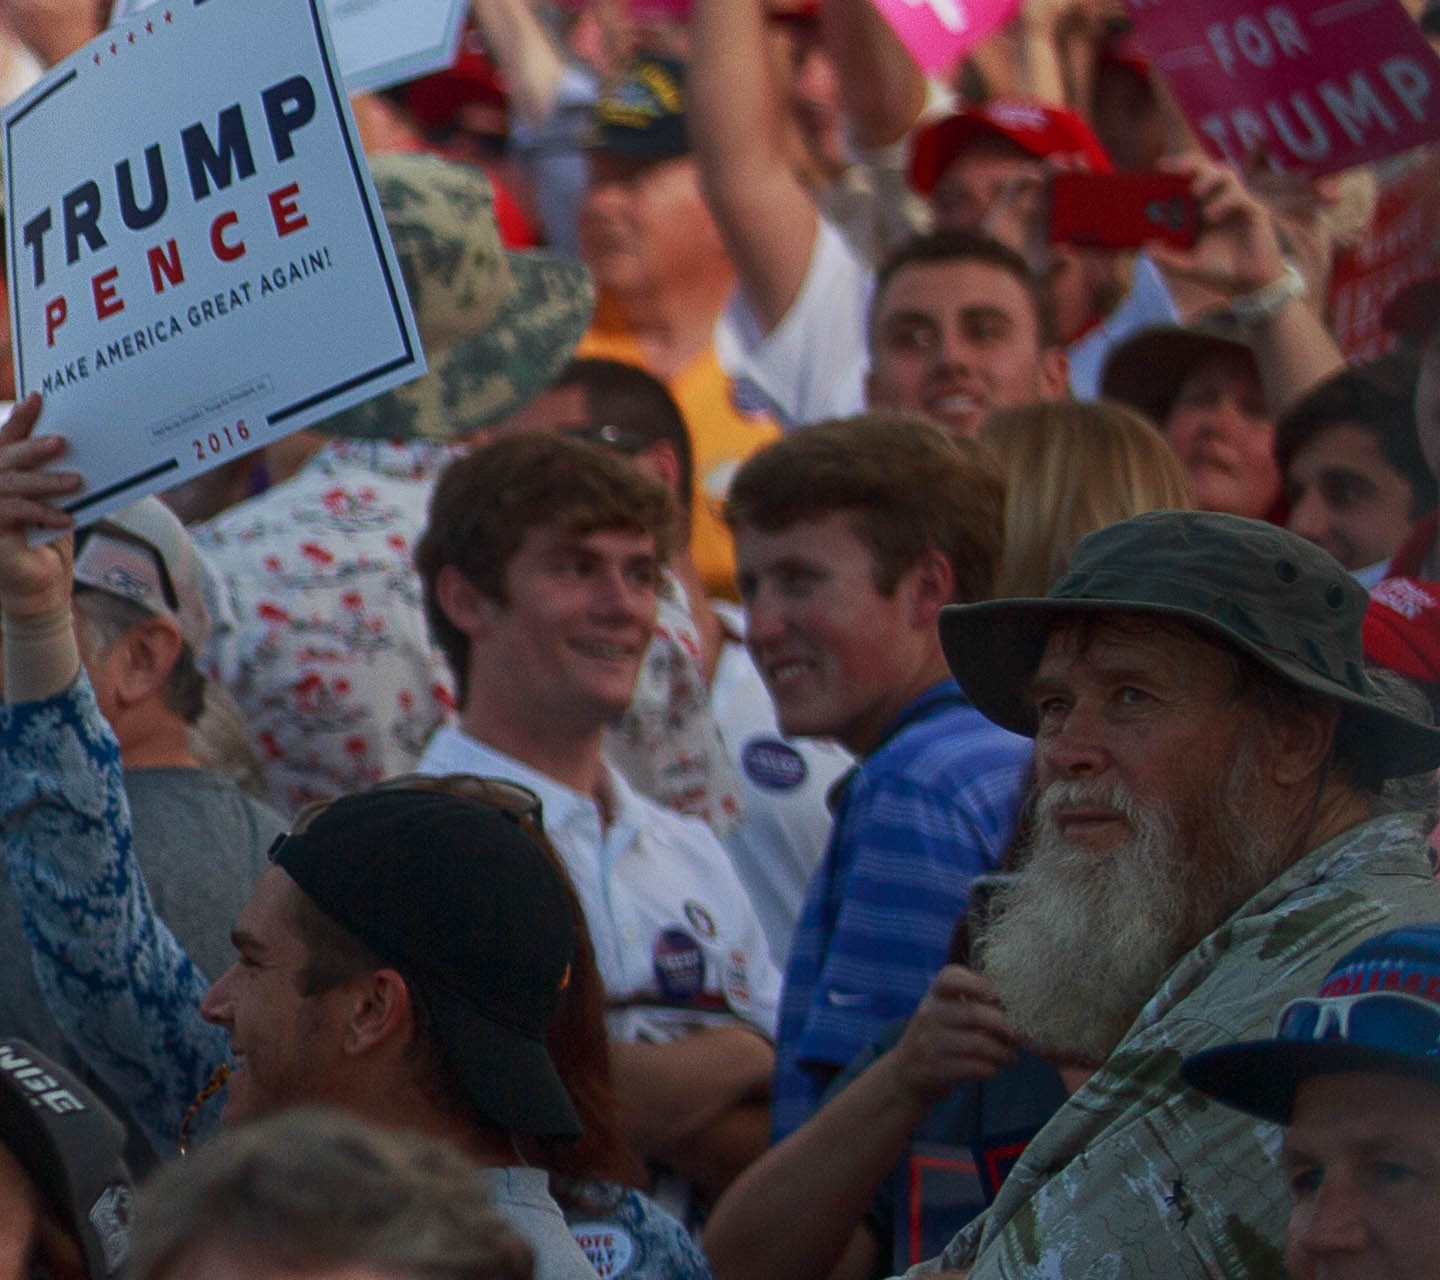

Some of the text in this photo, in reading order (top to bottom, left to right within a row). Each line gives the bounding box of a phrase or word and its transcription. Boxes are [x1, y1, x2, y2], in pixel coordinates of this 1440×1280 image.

[1207, 4, 1313, 77] FOR
[23, 73, 317, 289] TRUMP
[41, 245, 334, 399] MAKE AMERICA GREAT AGAIN!
[45, 180, 310, 347] PENCE
[192, 419, 251, 461] 2016
